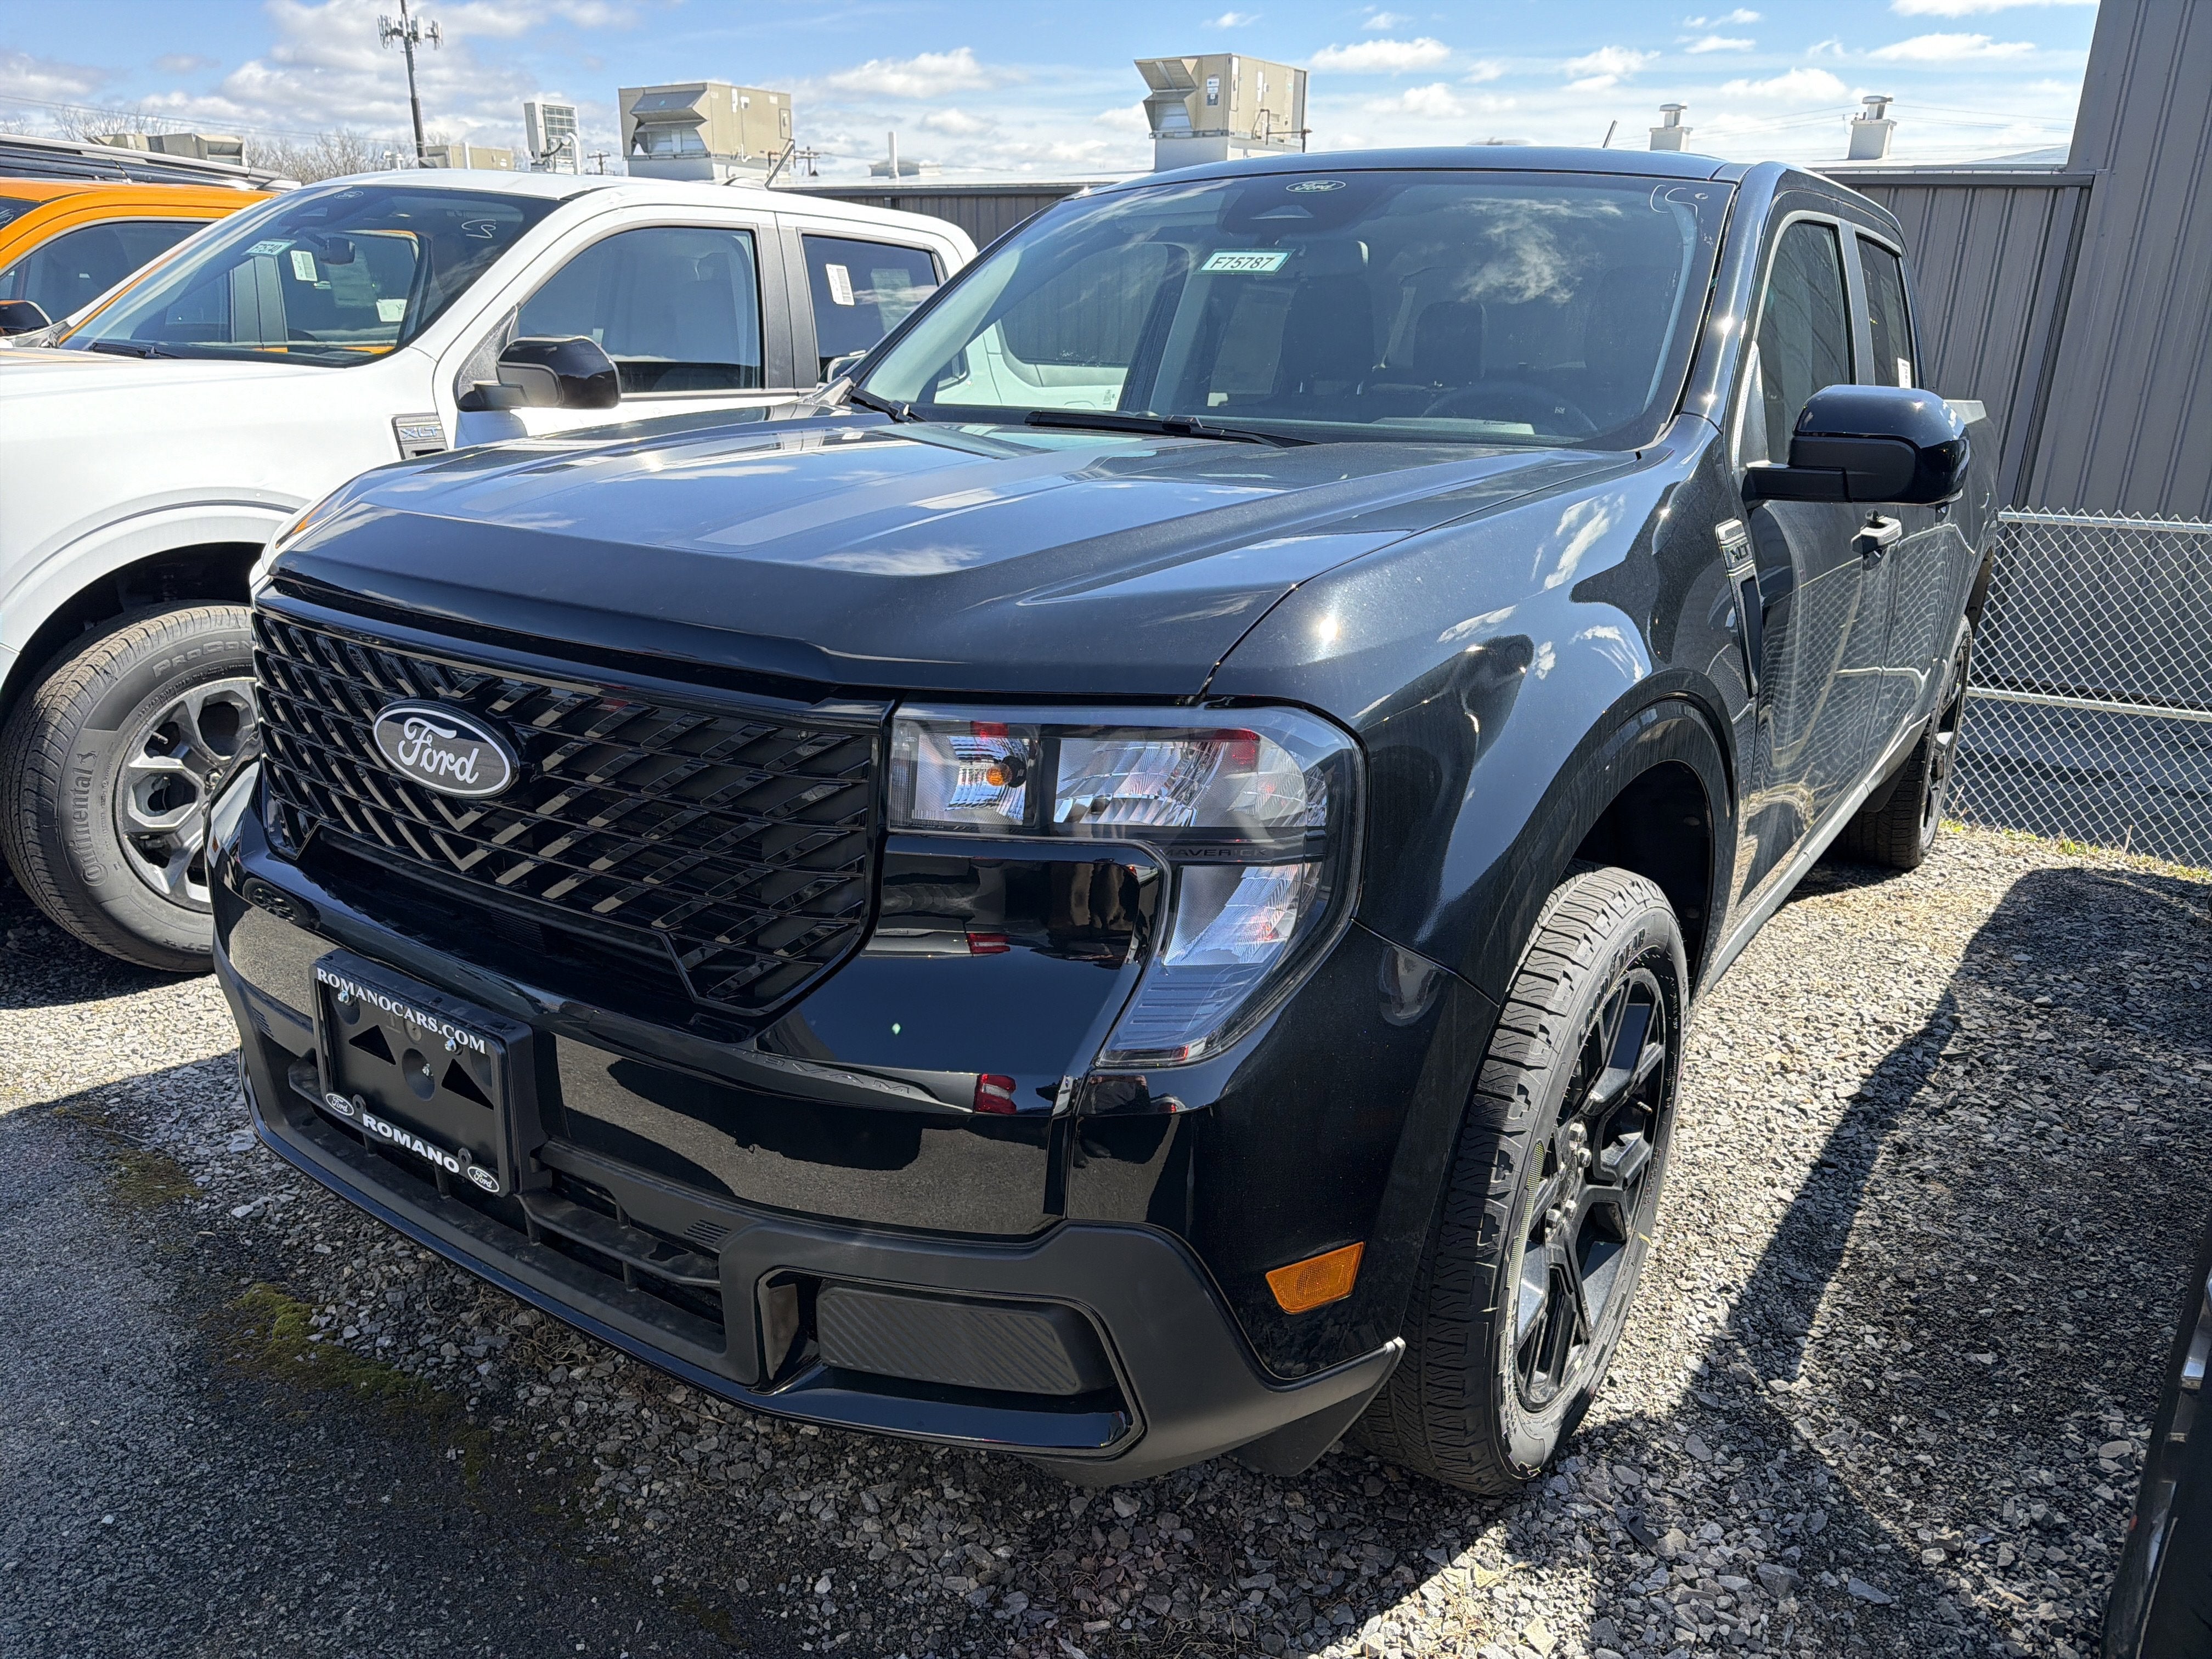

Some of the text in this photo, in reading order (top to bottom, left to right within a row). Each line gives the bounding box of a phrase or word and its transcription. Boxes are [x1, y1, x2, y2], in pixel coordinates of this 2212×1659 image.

[1294, 182, 1336, 190] Ford
[1209, 256, 1276, 269] F75787
[400, 426, 442, 439] XLT
[1729, 543, 1750, 563] XLT
[398, 716, 479, 784] Ford
[69, 767, 109, 887] Continental
[317, 967, 486, 1054] ROMANOCARS.COM
[328, 1096, 348, 1113] Ford
[362, 1113, 460, 1173] ROMANO
[473, 1168, 493, 1188] Ford
